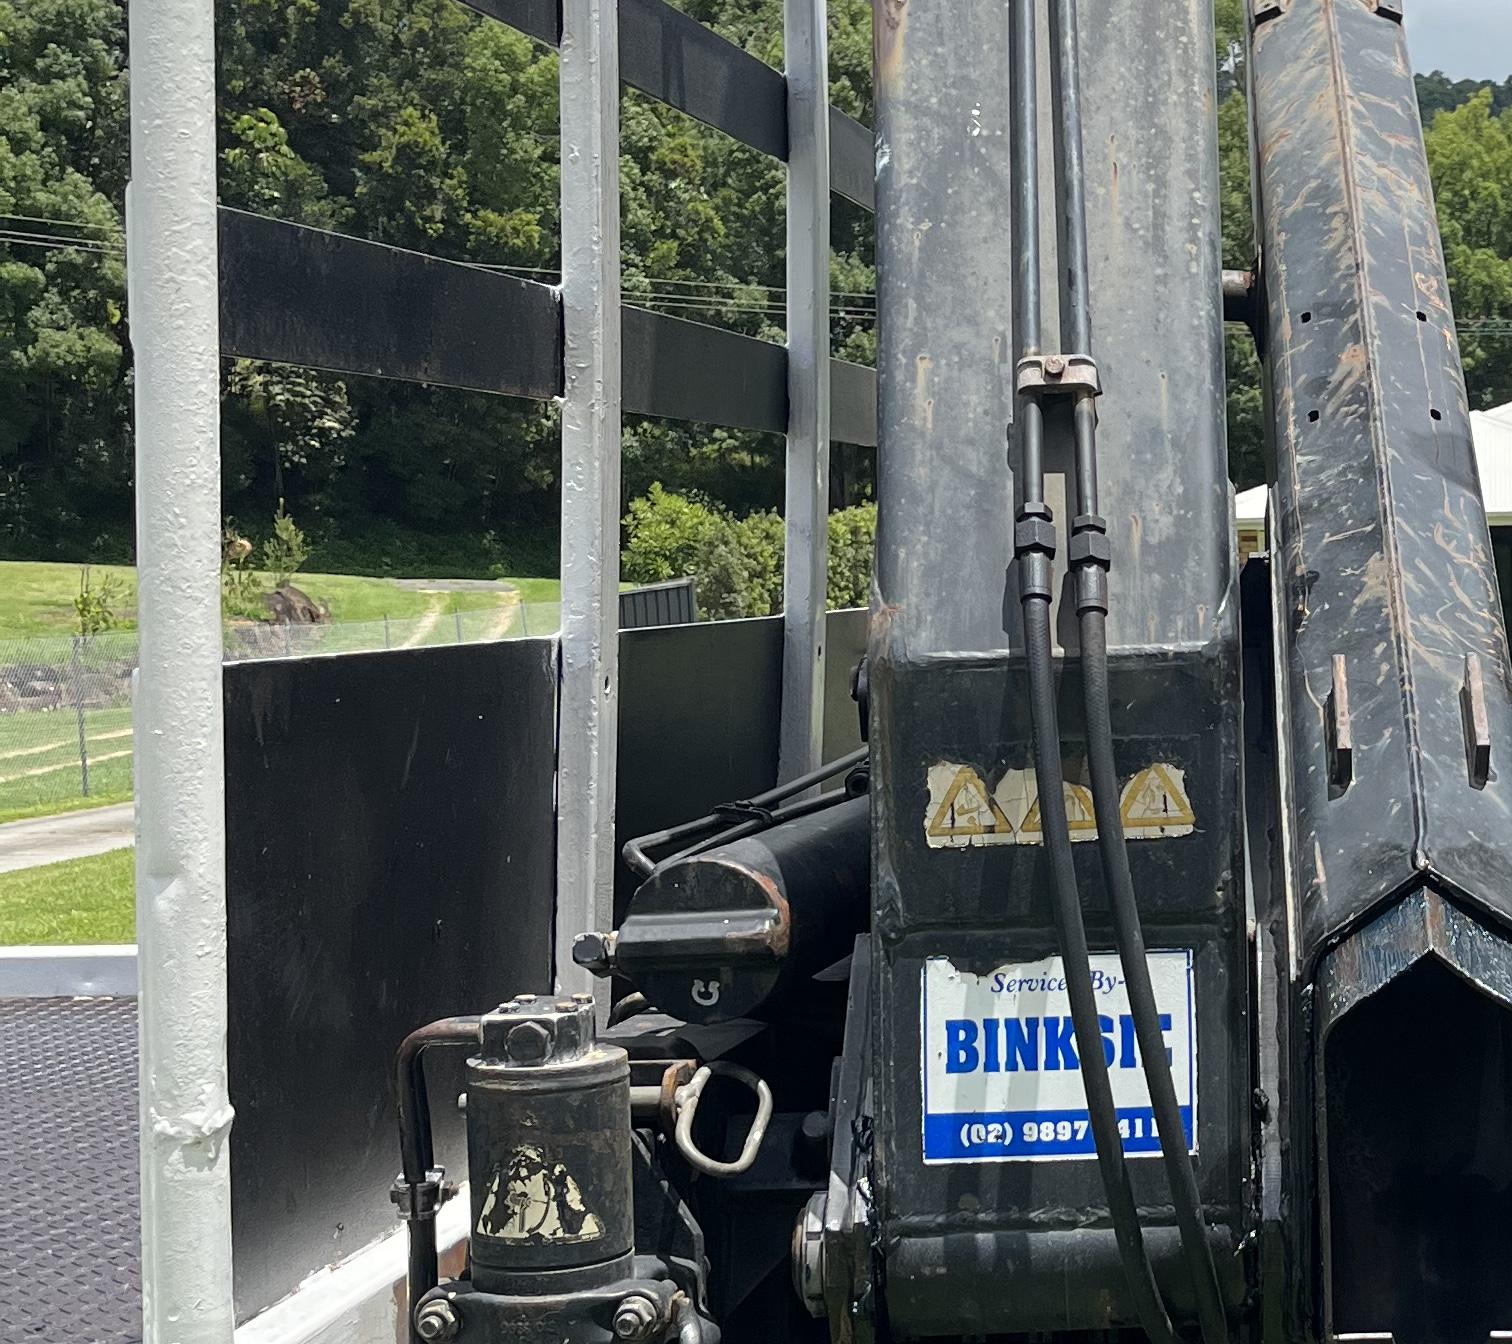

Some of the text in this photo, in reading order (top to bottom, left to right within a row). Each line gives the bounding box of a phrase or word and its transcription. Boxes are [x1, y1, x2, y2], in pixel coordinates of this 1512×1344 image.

[991, 971, 1068, 993] Service
[960, 1122, 1014, 1147] (02)
[1023, 1120, 1089, 1142] 9897
